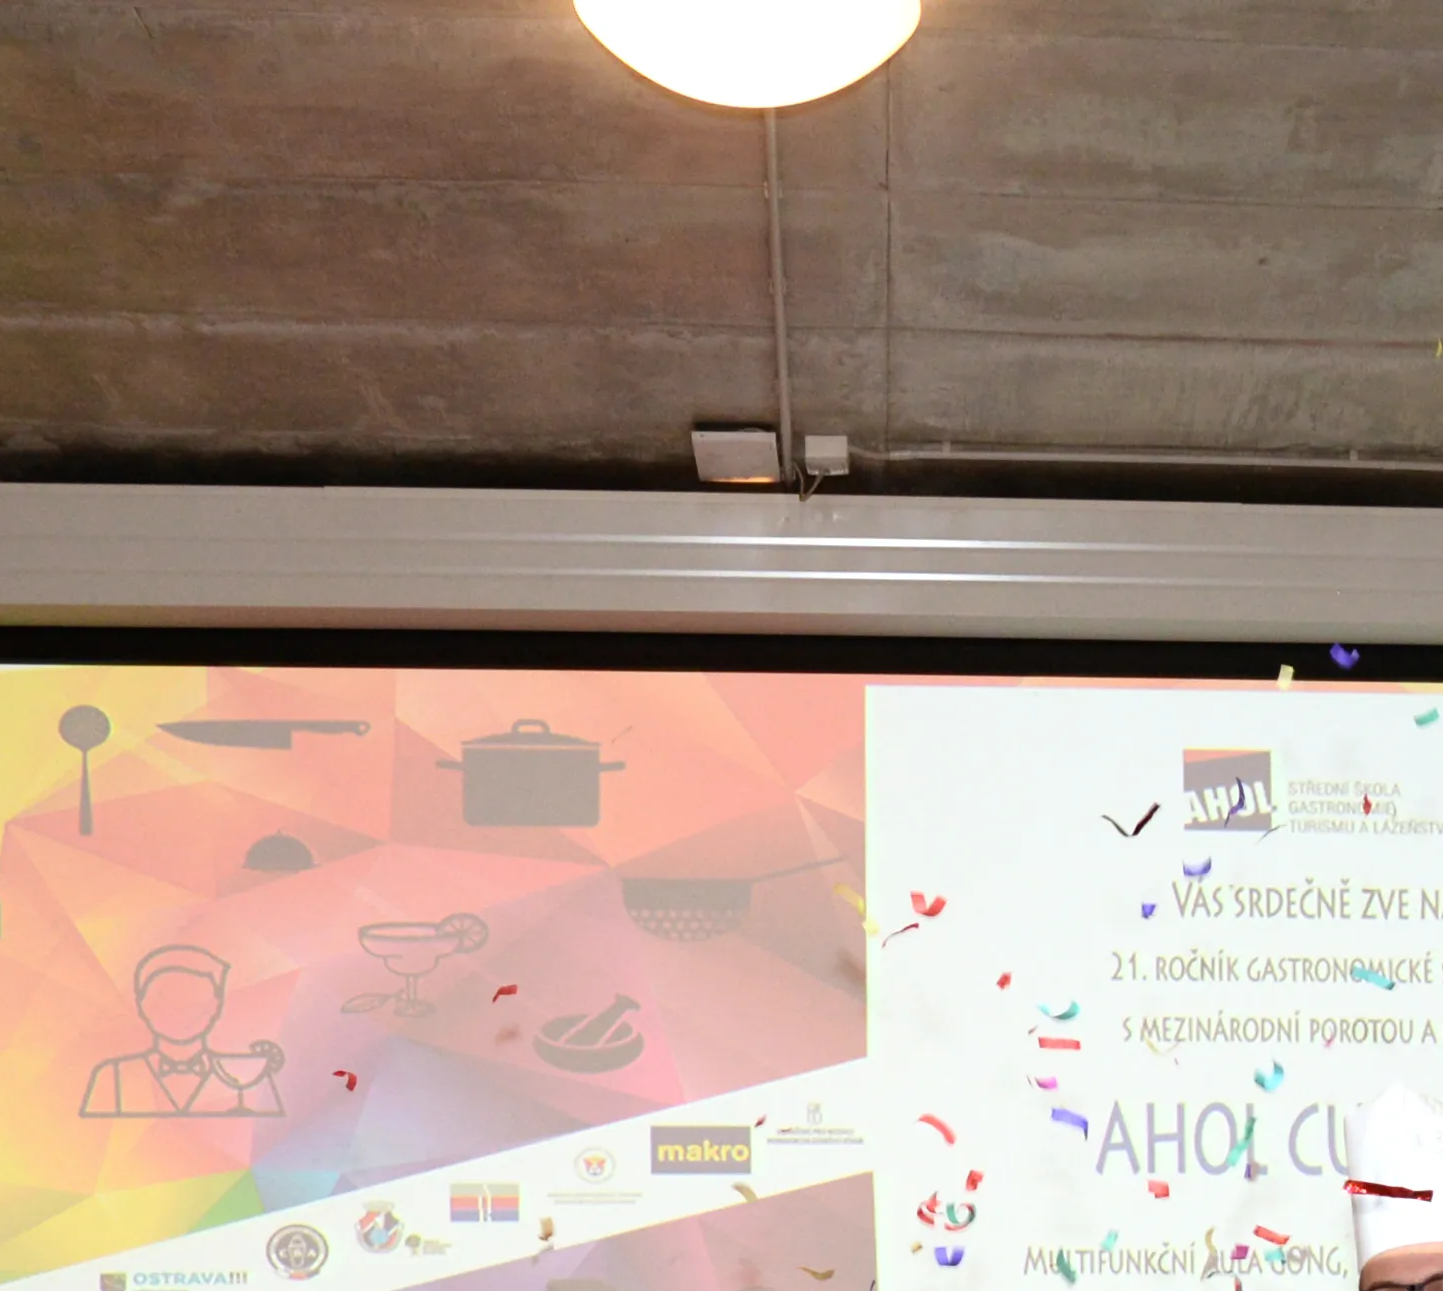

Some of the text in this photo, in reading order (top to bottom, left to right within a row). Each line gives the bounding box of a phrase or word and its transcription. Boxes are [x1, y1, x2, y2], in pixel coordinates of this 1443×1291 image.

[1172, 877, 1223, 918] VÁS
[1234, 878, 1352, 919] SRDEČNĚ
[1361, 888, 1409, 920] ZVE
[1111, 951, 1148, 981] 21.
[1156, 949, 1239, 982] ROČNÍK
[1123, 1018, 1133, 1042] S
[1140, 1010, 1300, 1043] MEZINÁRODNÍ
[1310, 1017, 1414, 1044] POROTOU
[1421, 1019, 1437, 1044] A
[658, 1140, 750, 1162] makro
[1288, 1102, 1350, 1177] CU
